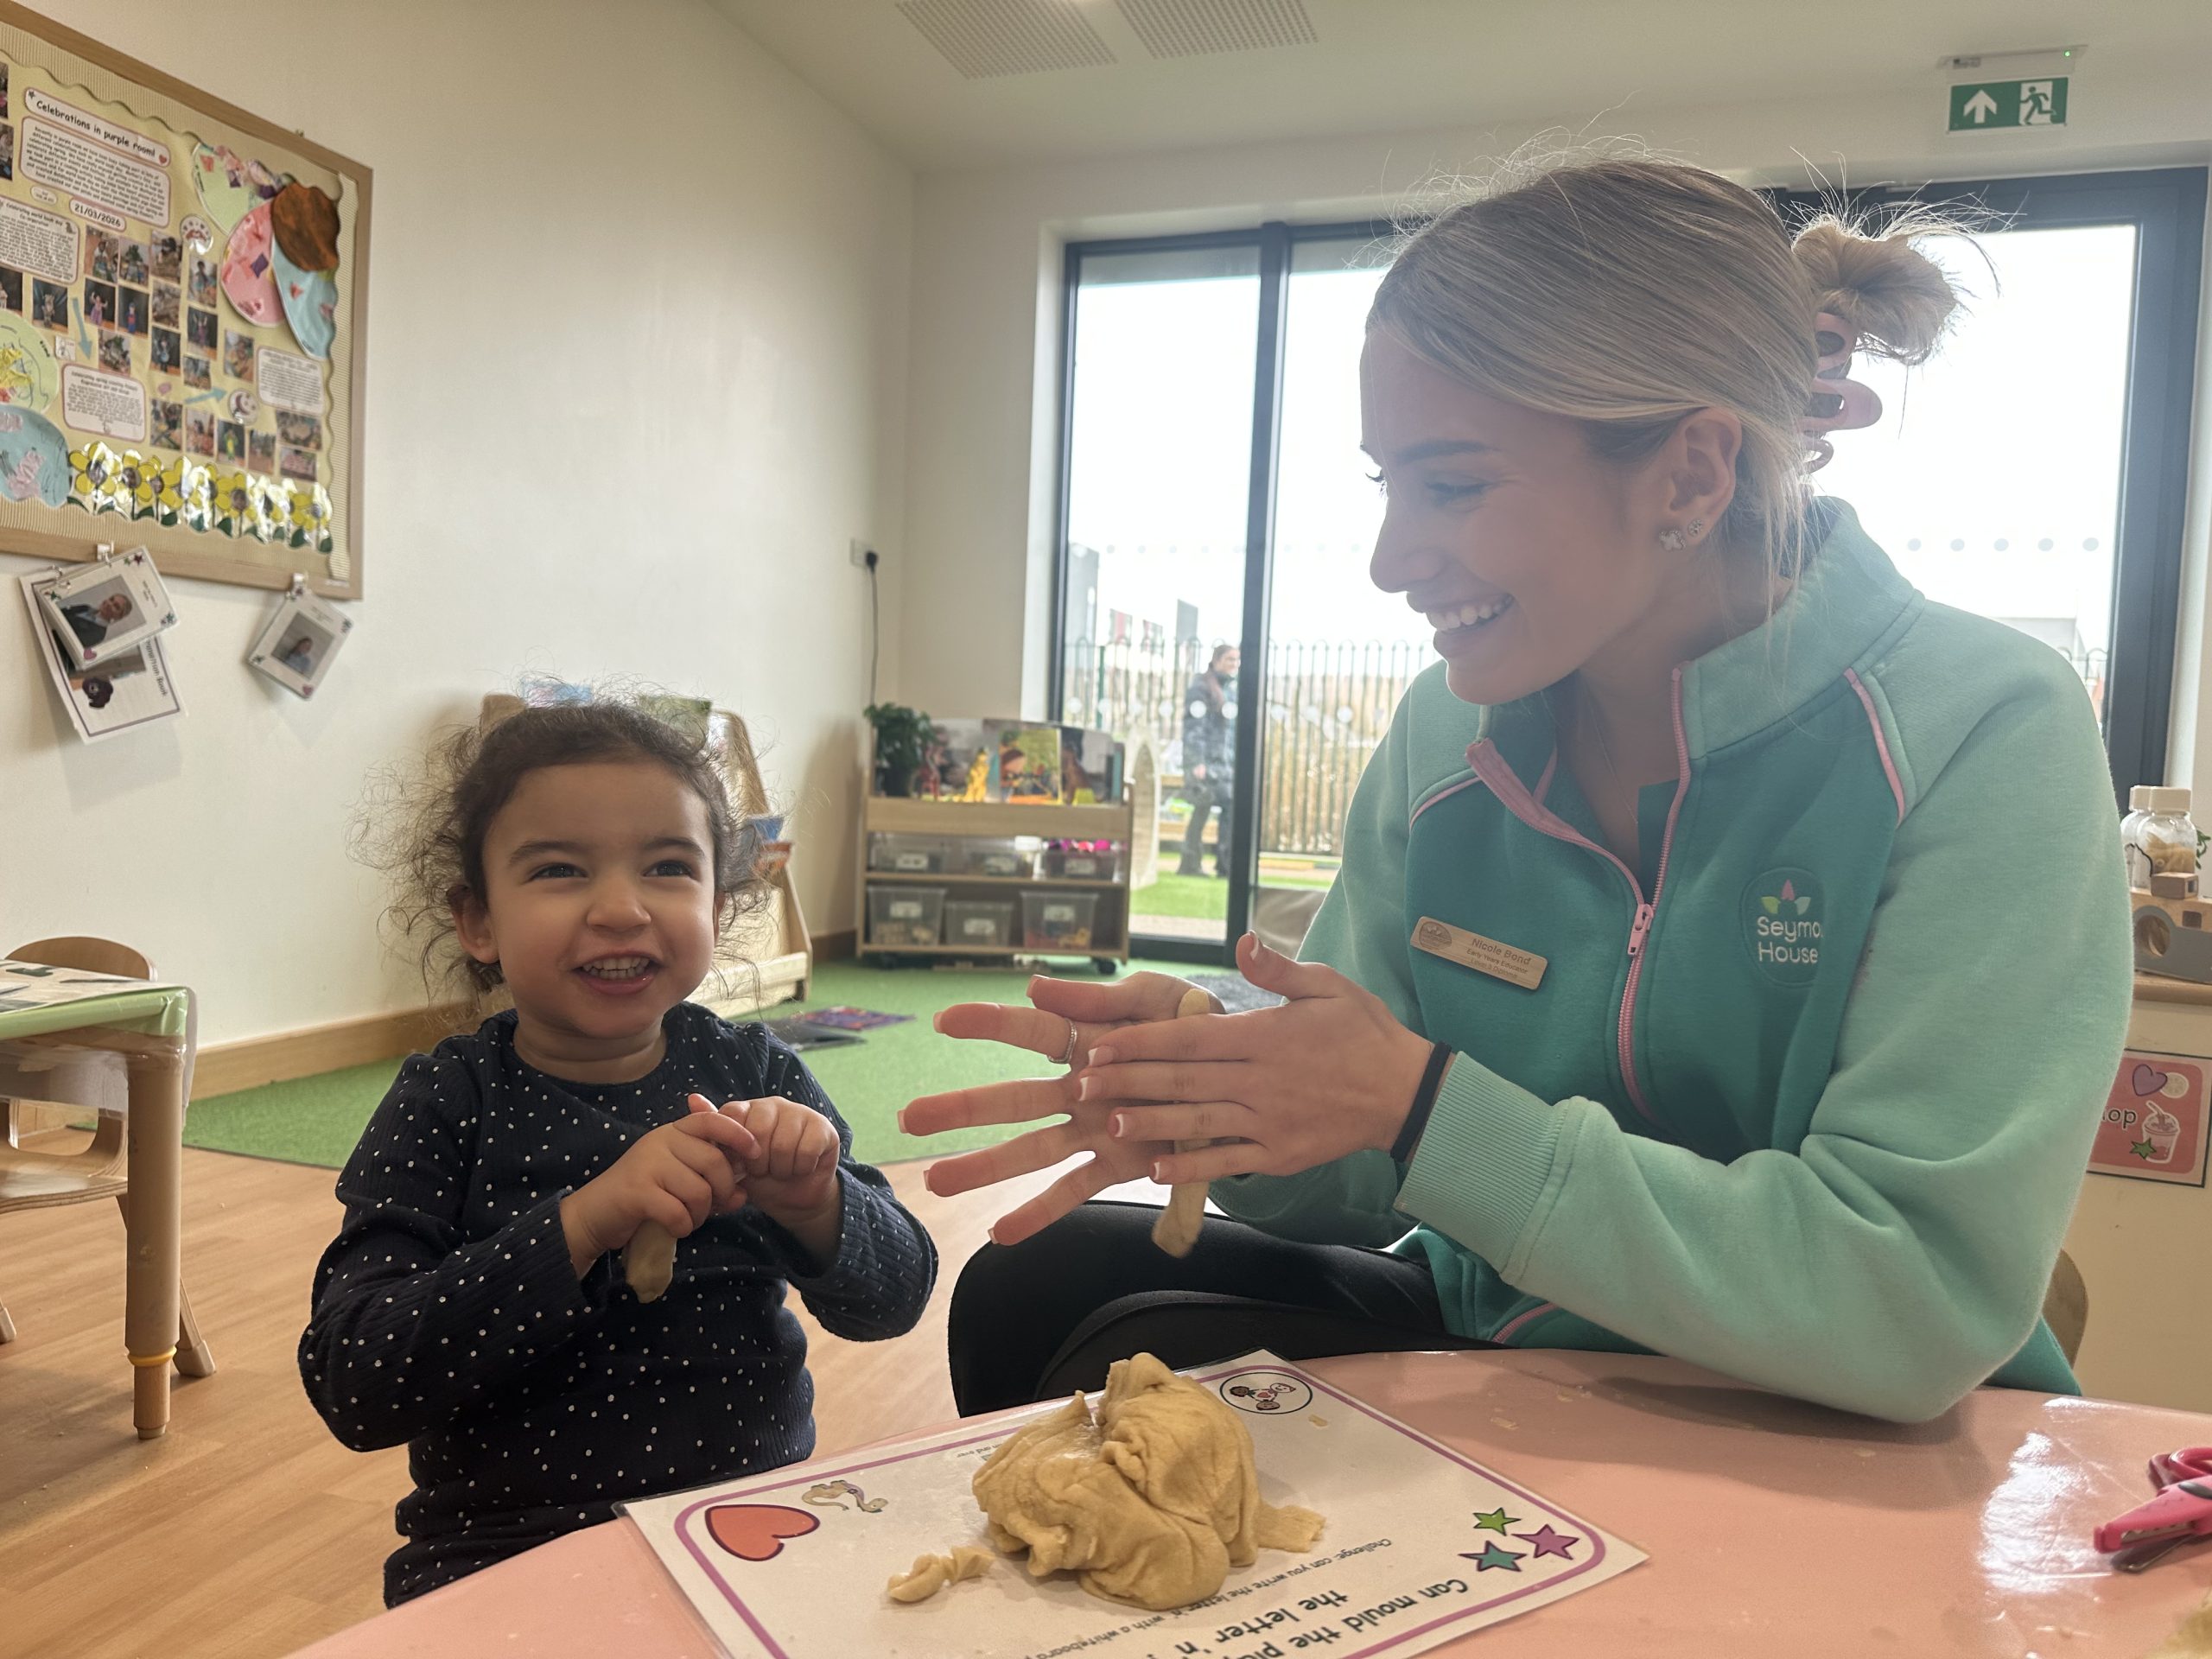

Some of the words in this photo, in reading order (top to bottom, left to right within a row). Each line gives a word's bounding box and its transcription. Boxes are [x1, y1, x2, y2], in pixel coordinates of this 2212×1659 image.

[36, 100, 91, 130] Celebrations
[93, 124, 101, 134] in
[104, 130, 130, 148] purple
[133, 142, 156, 157] room!
[1757, 915, 1824, 943] Seymo
[1466, 949, 1484, 959] Early
[1484, 954, 1500, 965] Years
[1501, 961, 1529, 975] Educator
[1472, 938, 1502, 956] Nicole
[1504, 950, 1532, 965] Bond
[1758, 941, 1819, 964] House
[1287, 1563, 1311, 1577] you
[1310, 1558, 1332, 1568] can
[1228, 1586, 1253, 1598] the
[1253, 1574, 1288, 1589] write
[1417, 1579, 1469, 1599] Can
[1297, 1590, 1349, 1611] the
[1132, 1615, 1165, 1630] with
[1215, 1607, 1300, 1643] letter
[1341, 1595, 1418, 1633] mould
[1287, 1626, 1342, 1649] the
